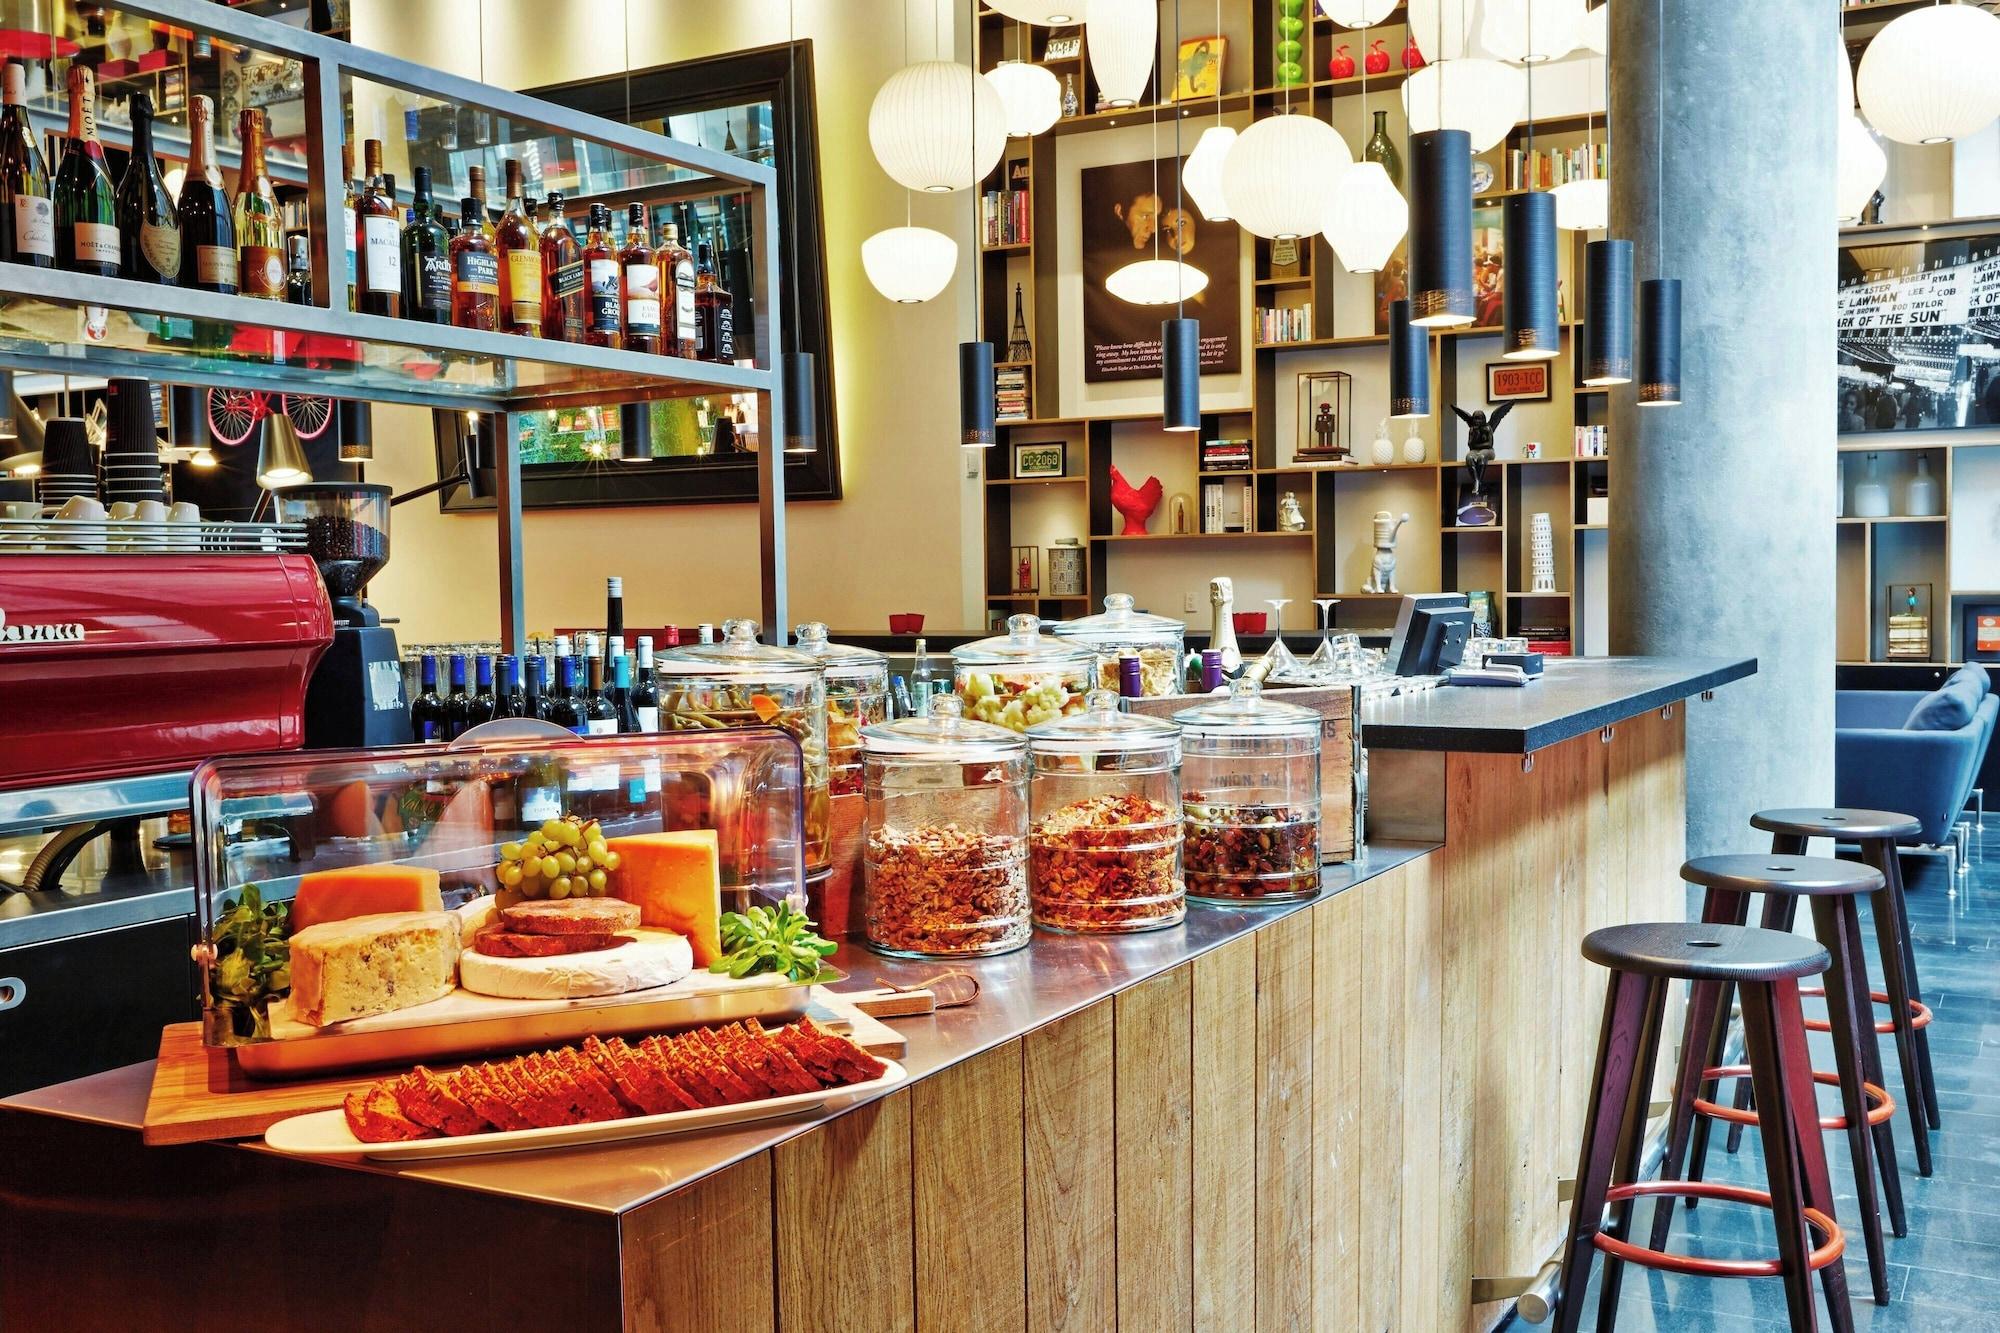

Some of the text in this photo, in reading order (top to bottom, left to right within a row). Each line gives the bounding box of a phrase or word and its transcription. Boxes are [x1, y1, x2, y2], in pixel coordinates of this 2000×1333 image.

[388, 256, 397, 267] 12
[477, 266, 494, 276] PARK
[558, 274, 574, 284] BLACK
[1899, 272, 1955, 285] ROBERT RYAN
[1849, 292, 1898, 308] LAWMAN
[1856, 306, 1881, 315] BROWN
[1891, 303, 1908, 312] ROD
[1912, 299, 1944, 310] TAYLOR
[1858, 315, 1875, 327] OF
[1879, 313, 1904, 326] THE
[1909, 310, 1941, 324] SUN
